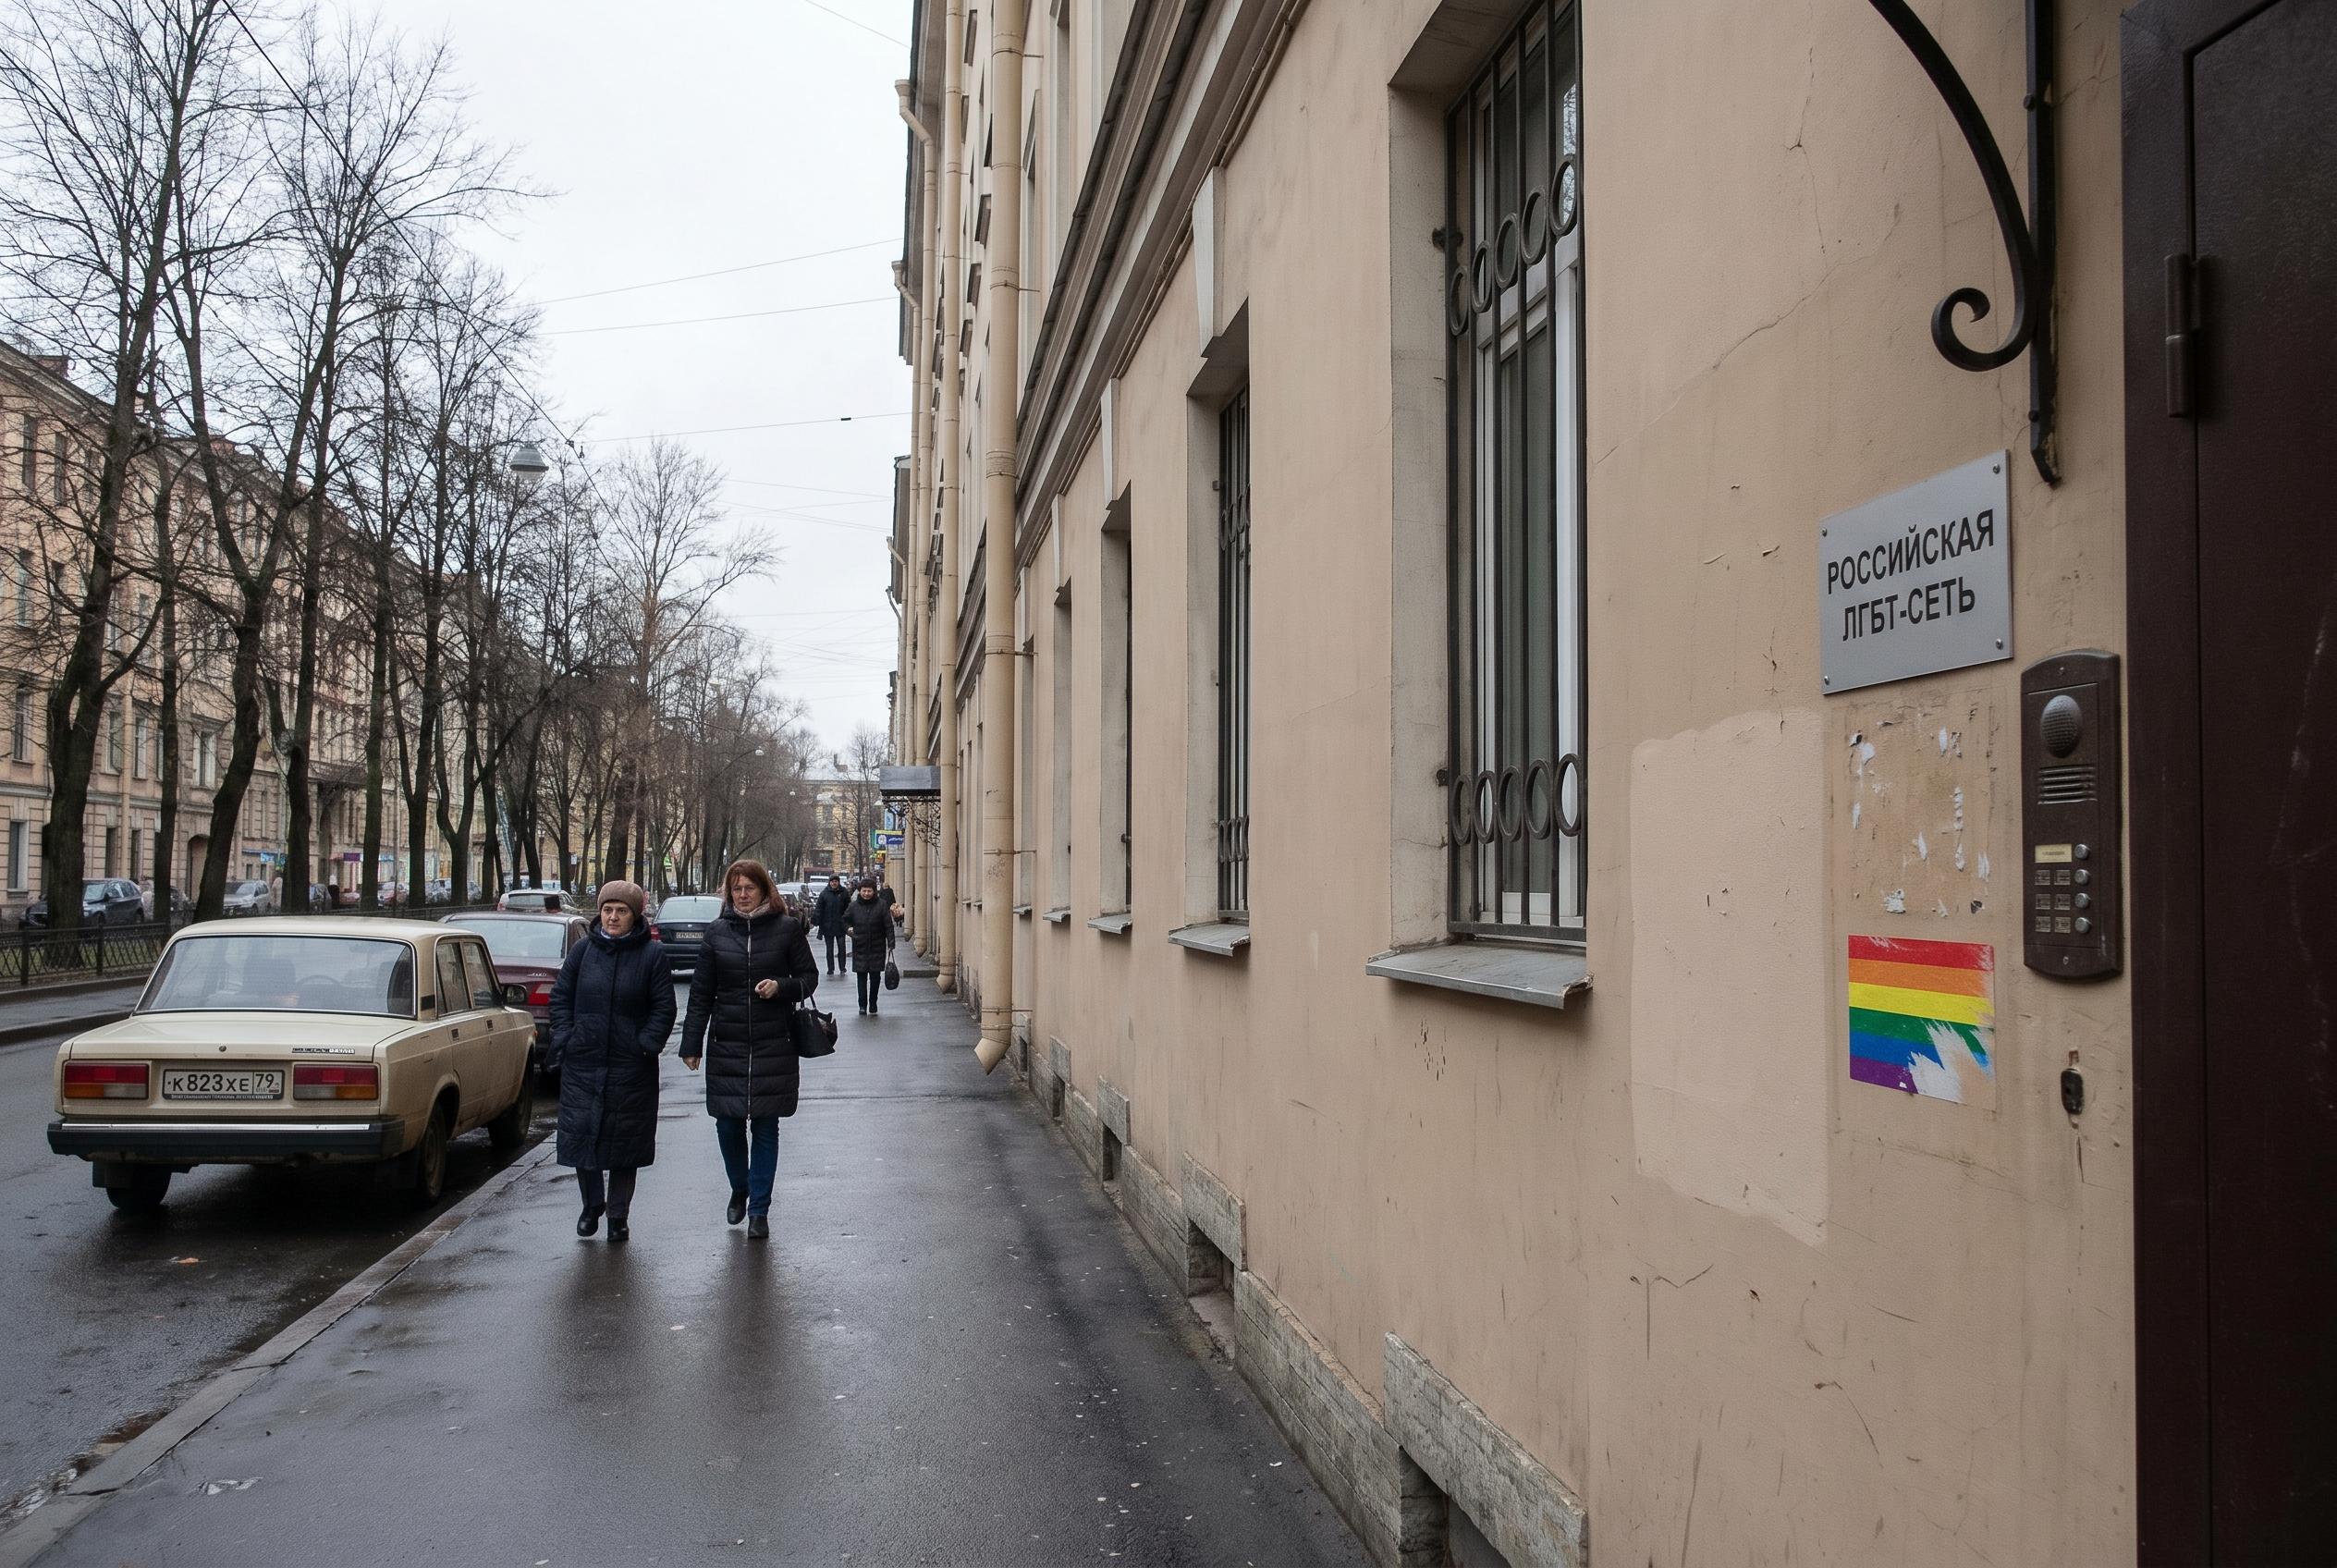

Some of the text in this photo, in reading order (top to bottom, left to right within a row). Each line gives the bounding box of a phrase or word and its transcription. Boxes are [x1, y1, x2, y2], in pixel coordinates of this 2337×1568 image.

[1828, 508, 1994, 594] РОССИЙСКАЯ
[1842, 576, 1976, 642] ЛГБТ-СЕТЬ
[255, 1073, 275, 1089] 79
